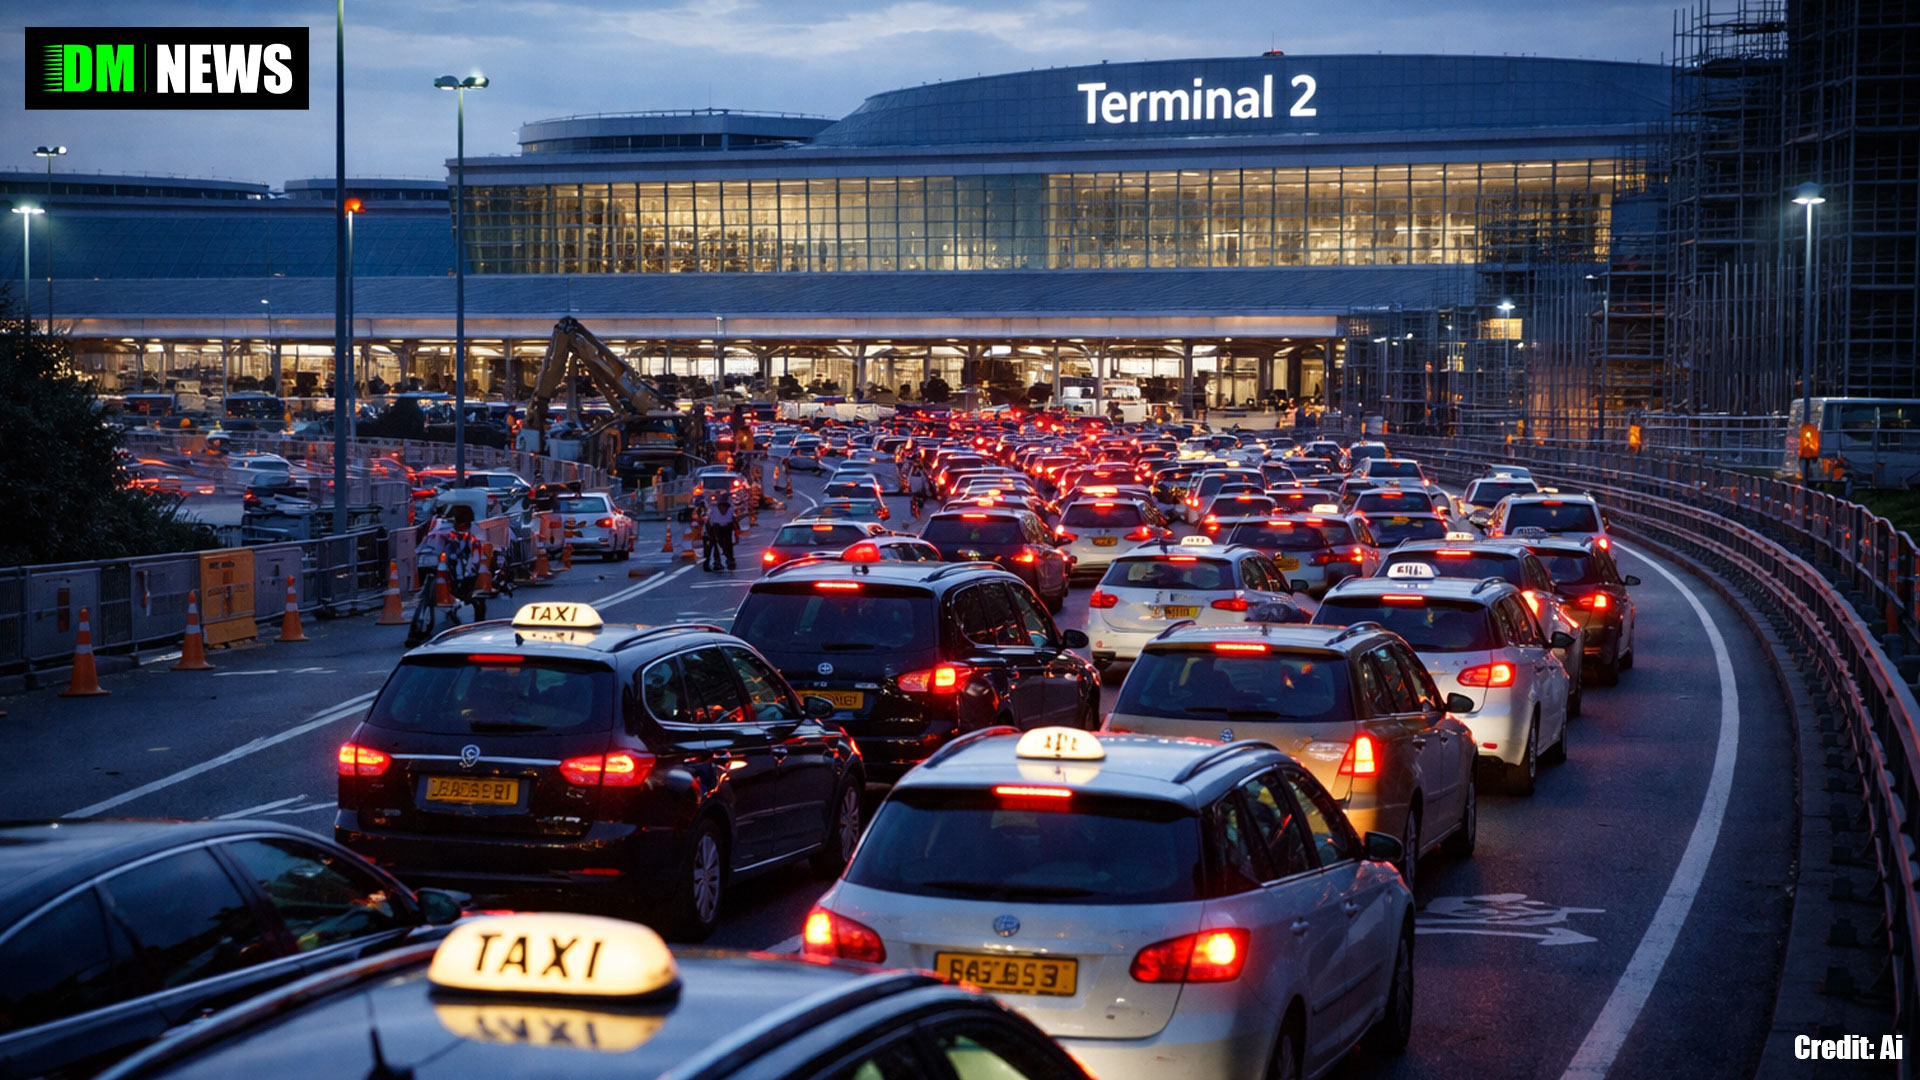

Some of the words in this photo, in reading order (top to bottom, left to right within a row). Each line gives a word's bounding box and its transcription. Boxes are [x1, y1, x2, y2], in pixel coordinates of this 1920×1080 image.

[1077, 74, 1274, 124] Terminal
[1290, 74, 1317, 117] 2
[530, 605, 578, 622] TAXI
[476, 933, 602, 979] TAXI
